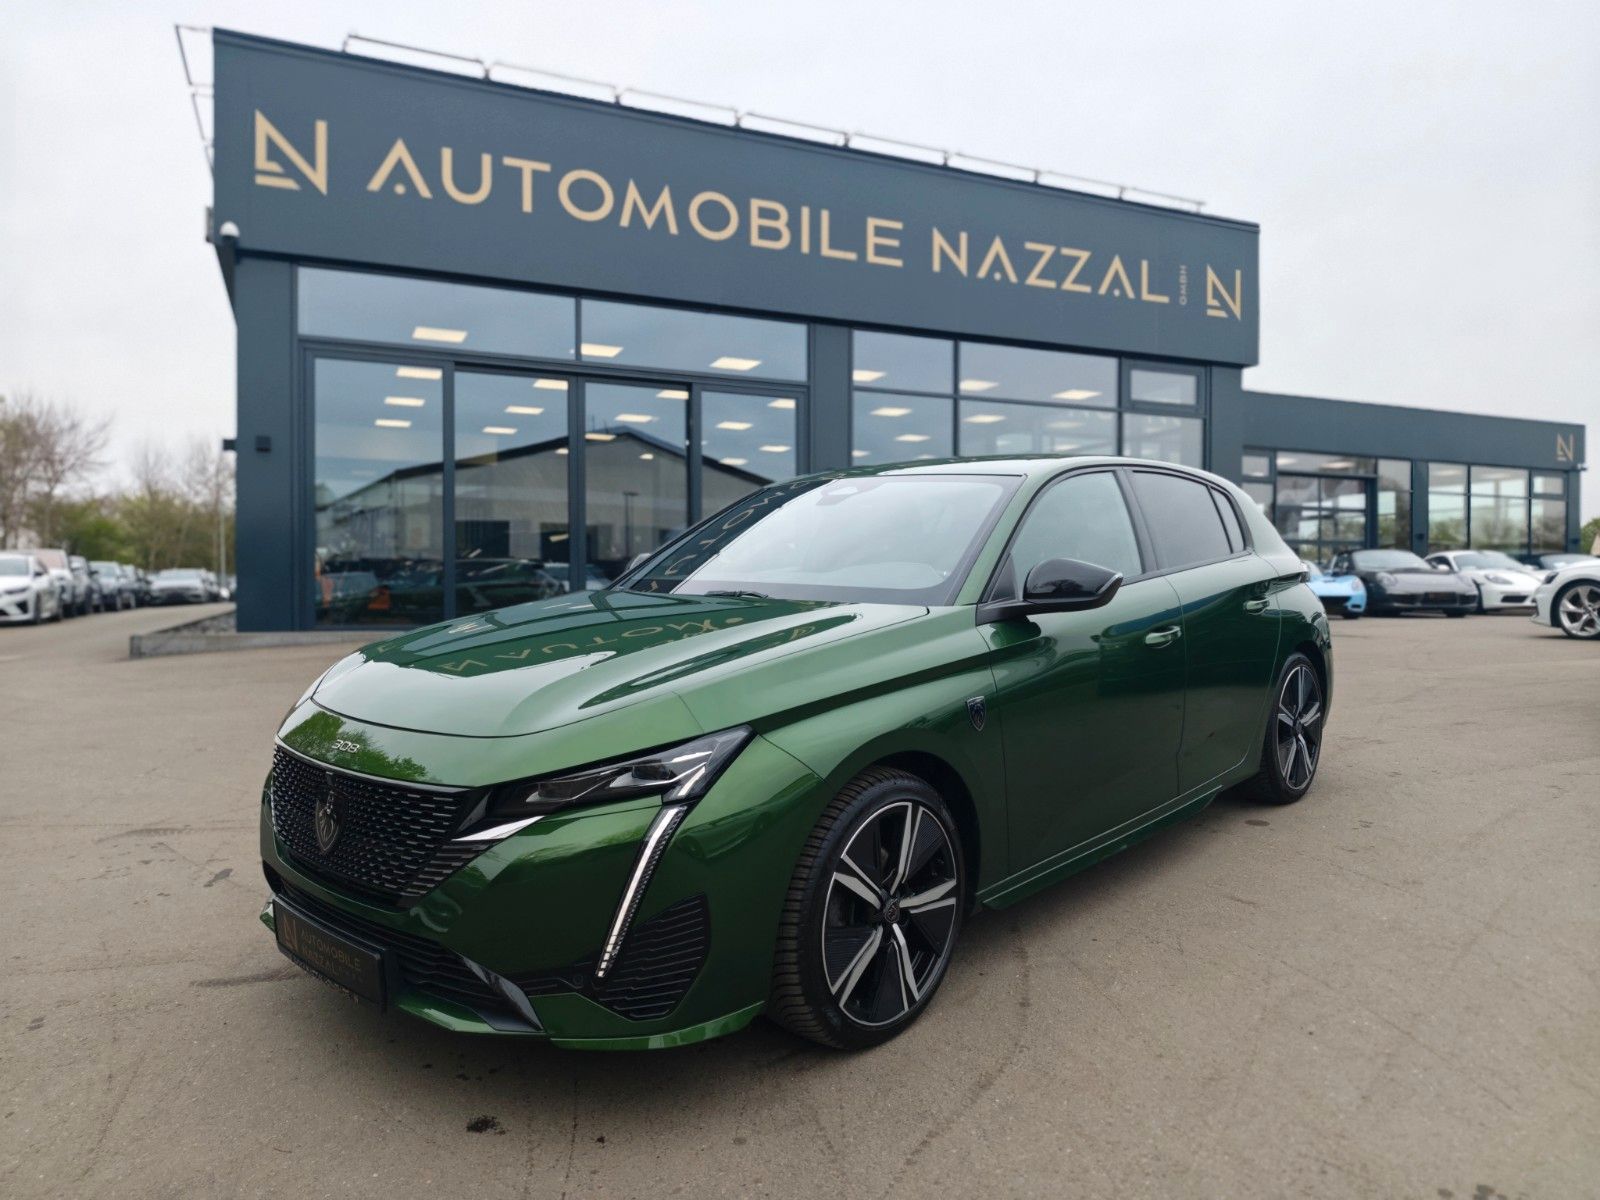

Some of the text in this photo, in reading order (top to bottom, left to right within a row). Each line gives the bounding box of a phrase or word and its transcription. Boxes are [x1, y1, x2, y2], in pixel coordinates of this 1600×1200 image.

[367, 137, 904, 269] AUTOMOBILE
[931, 227, 1170, 304] NAZZAL
[331, 739, 360, 754] 308
